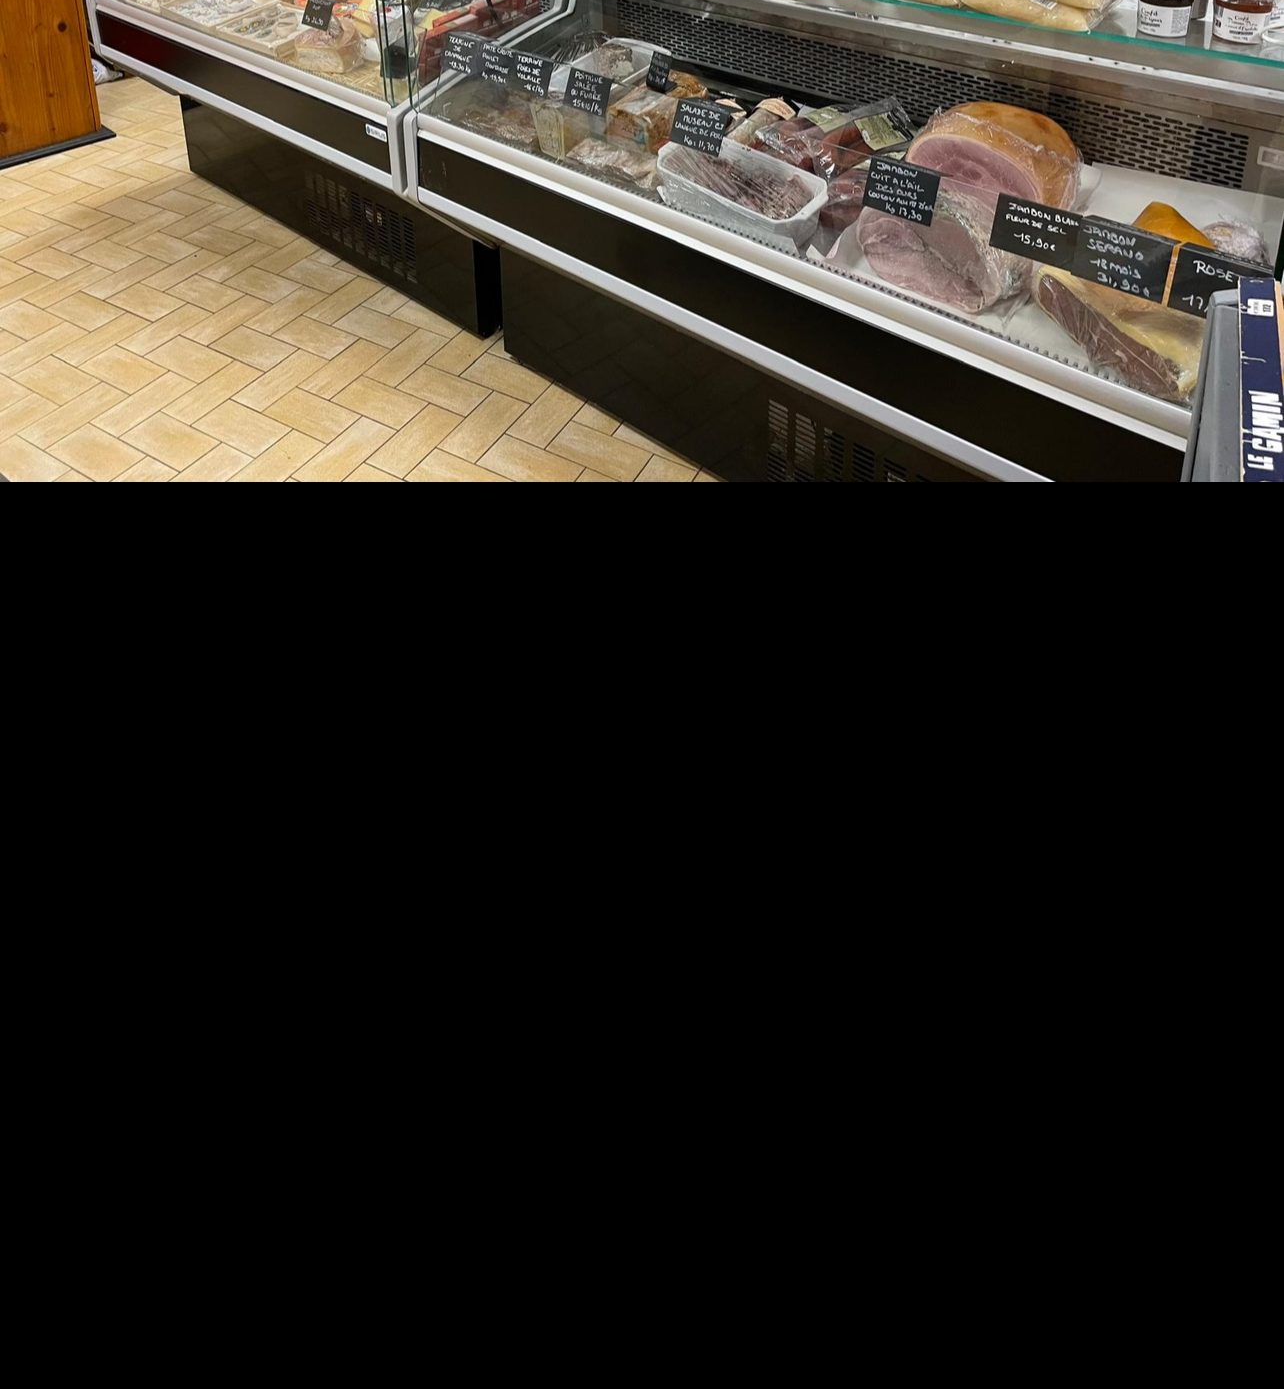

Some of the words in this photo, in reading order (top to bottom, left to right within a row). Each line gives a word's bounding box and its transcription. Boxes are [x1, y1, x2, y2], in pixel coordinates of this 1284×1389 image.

[680, 103, 708, 117] SALADE
[708, 111, 721, 121] DE
[683, 115, 713, 128] MUSEAU
[699, 128, 709, 137] DE
[876, 161, 918, 177] JAMBON
[875, 182, 894, 194] DES
[896, 189, 918, 200] OURS
[1008, 202, 1051, 222] JAMBON
[1005, 213, 1030, 226] FLEUR
[1031, 221, 1043, 229] DE
[1047, 224, 1067, 235] SEL
[1083, 224, 1137, 247] JAMBON
[1248, 390, 1284, 453] GAMIN
[1247, 453, 1274, 471] LE
